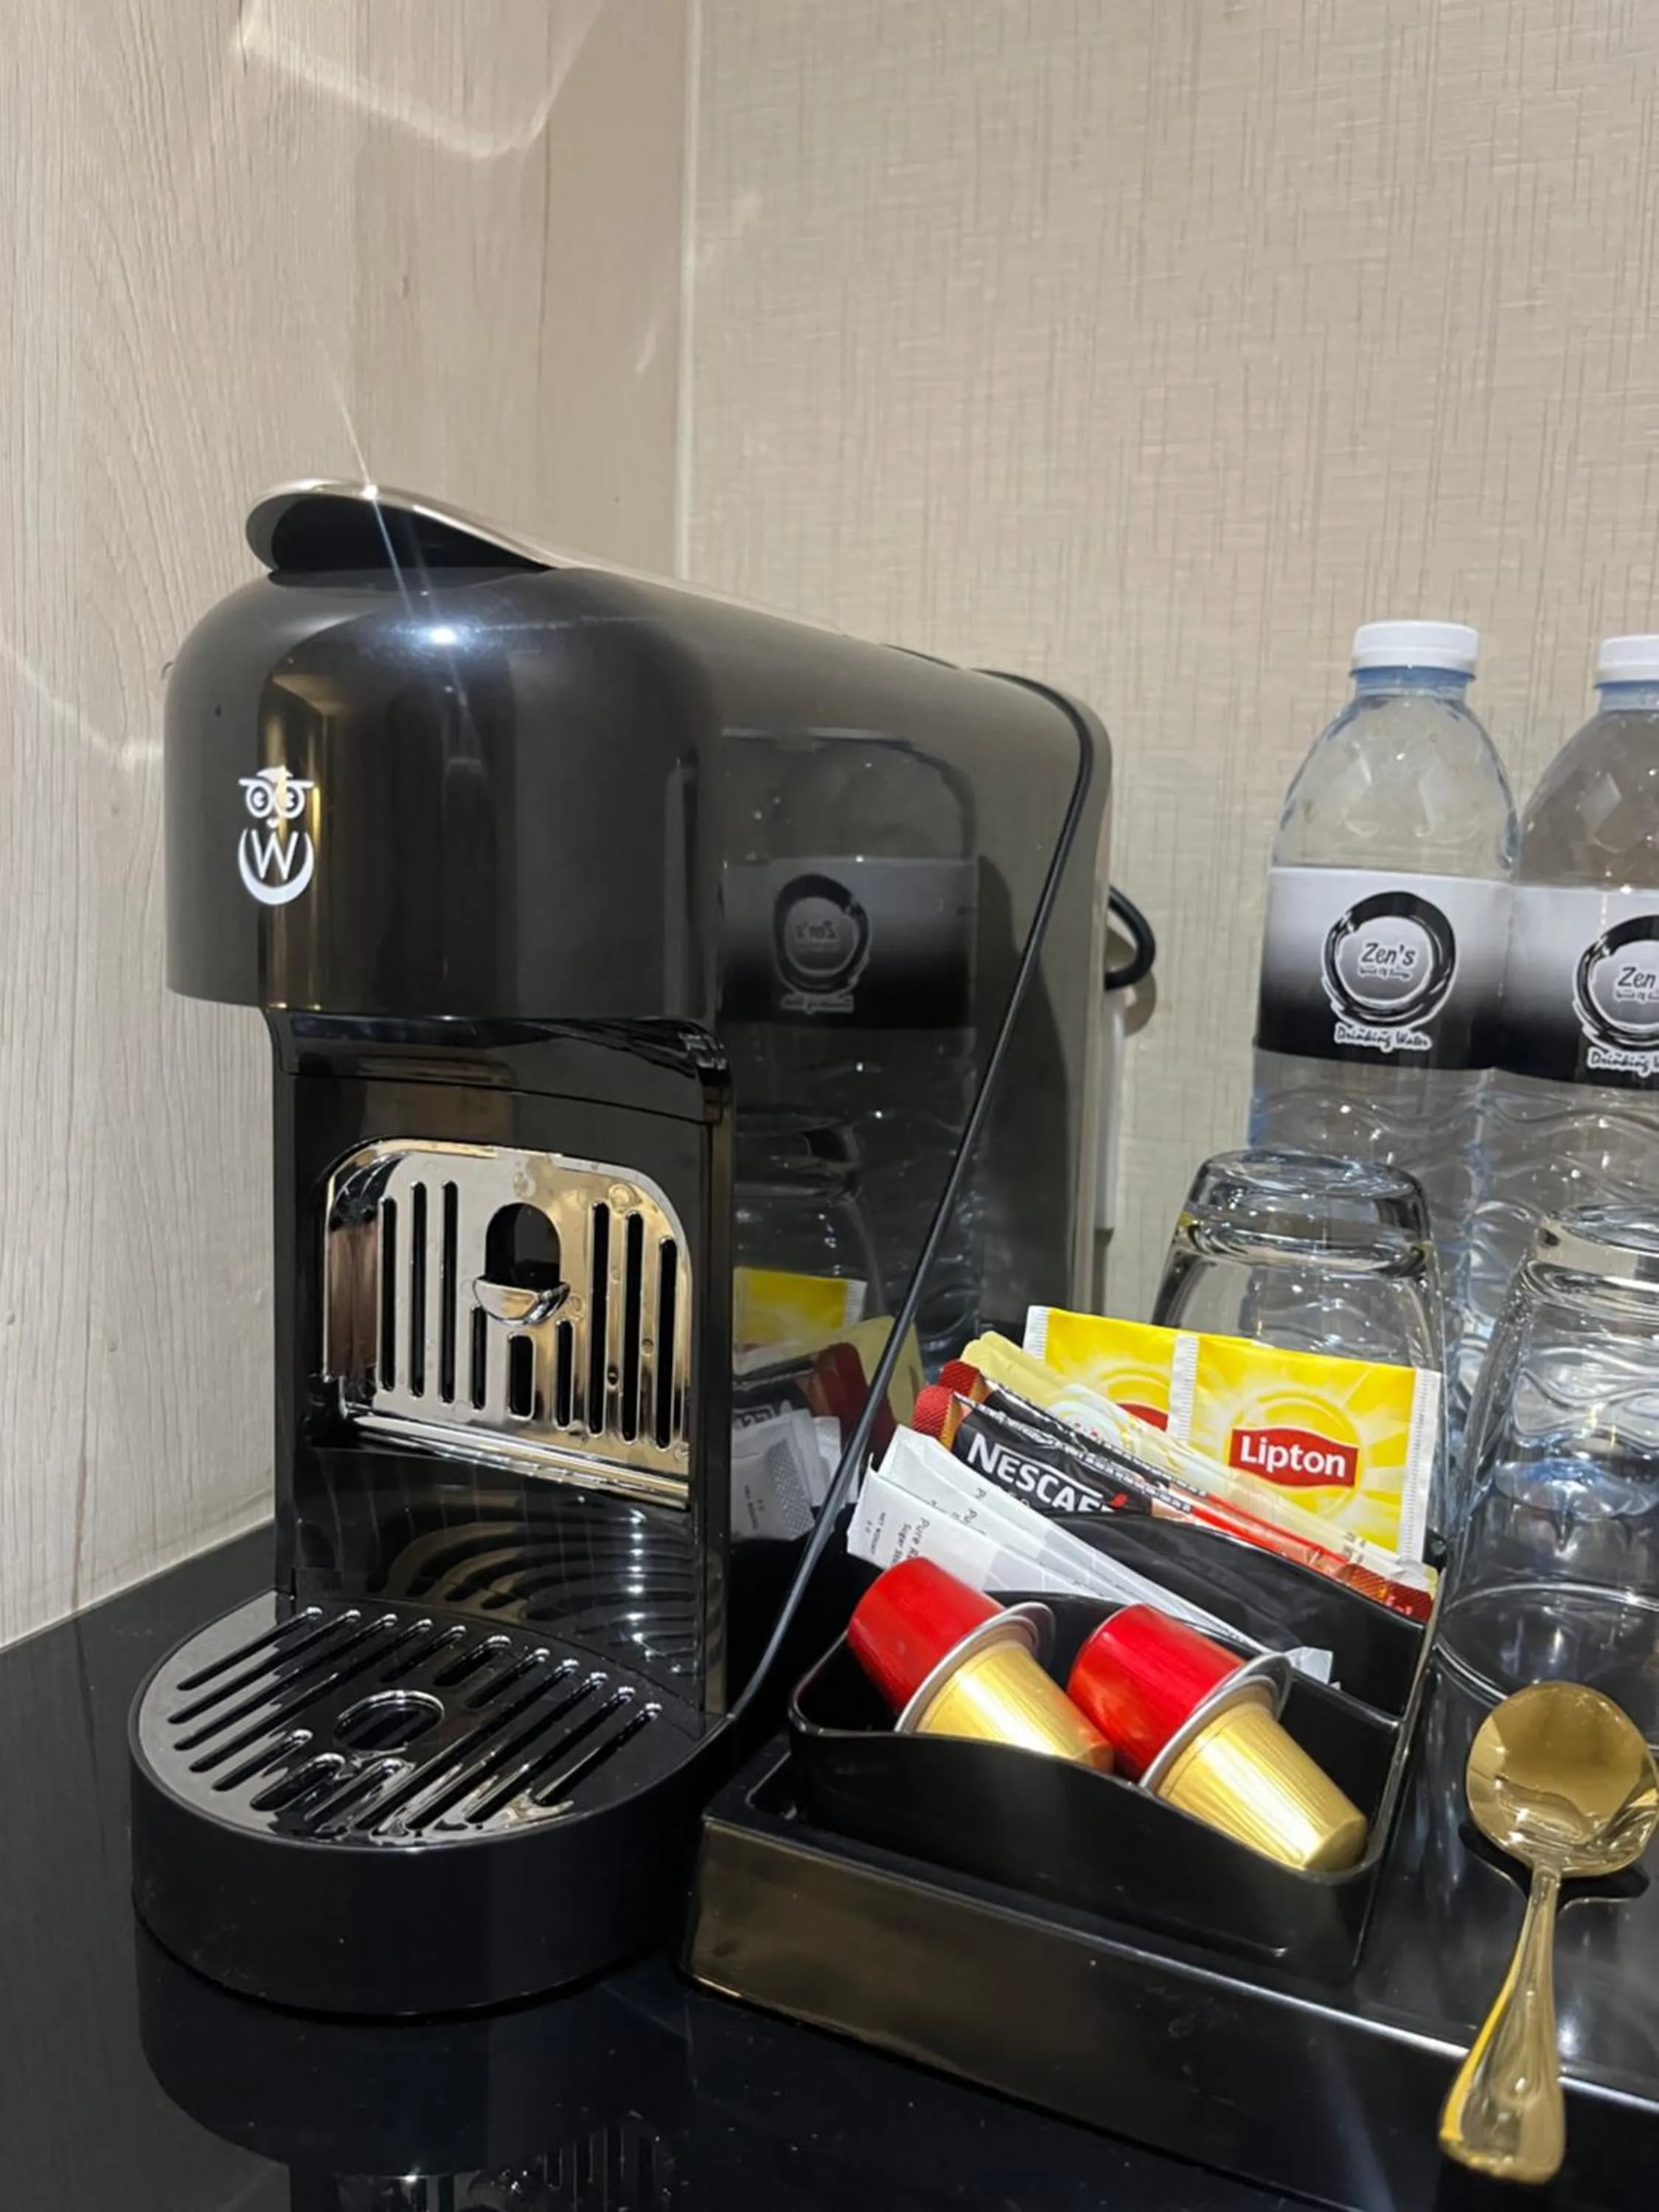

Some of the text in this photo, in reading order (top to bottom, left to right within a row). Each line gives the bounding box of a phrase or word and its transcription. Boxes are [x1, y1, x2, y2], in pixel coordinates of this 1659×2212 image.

[251, 829, 298, 881] W
[1360, 942, 1416, 967] Zen's
[1617, 966, 1657, 990] Zen
[1335, 1023, 1430, 1049] Drinking Water
[1591, 1049, 1650, 1074] Drinking
[1239, 1435, 1346, 1478] Lipton
[912, 1516, 931, 1545] Pure
